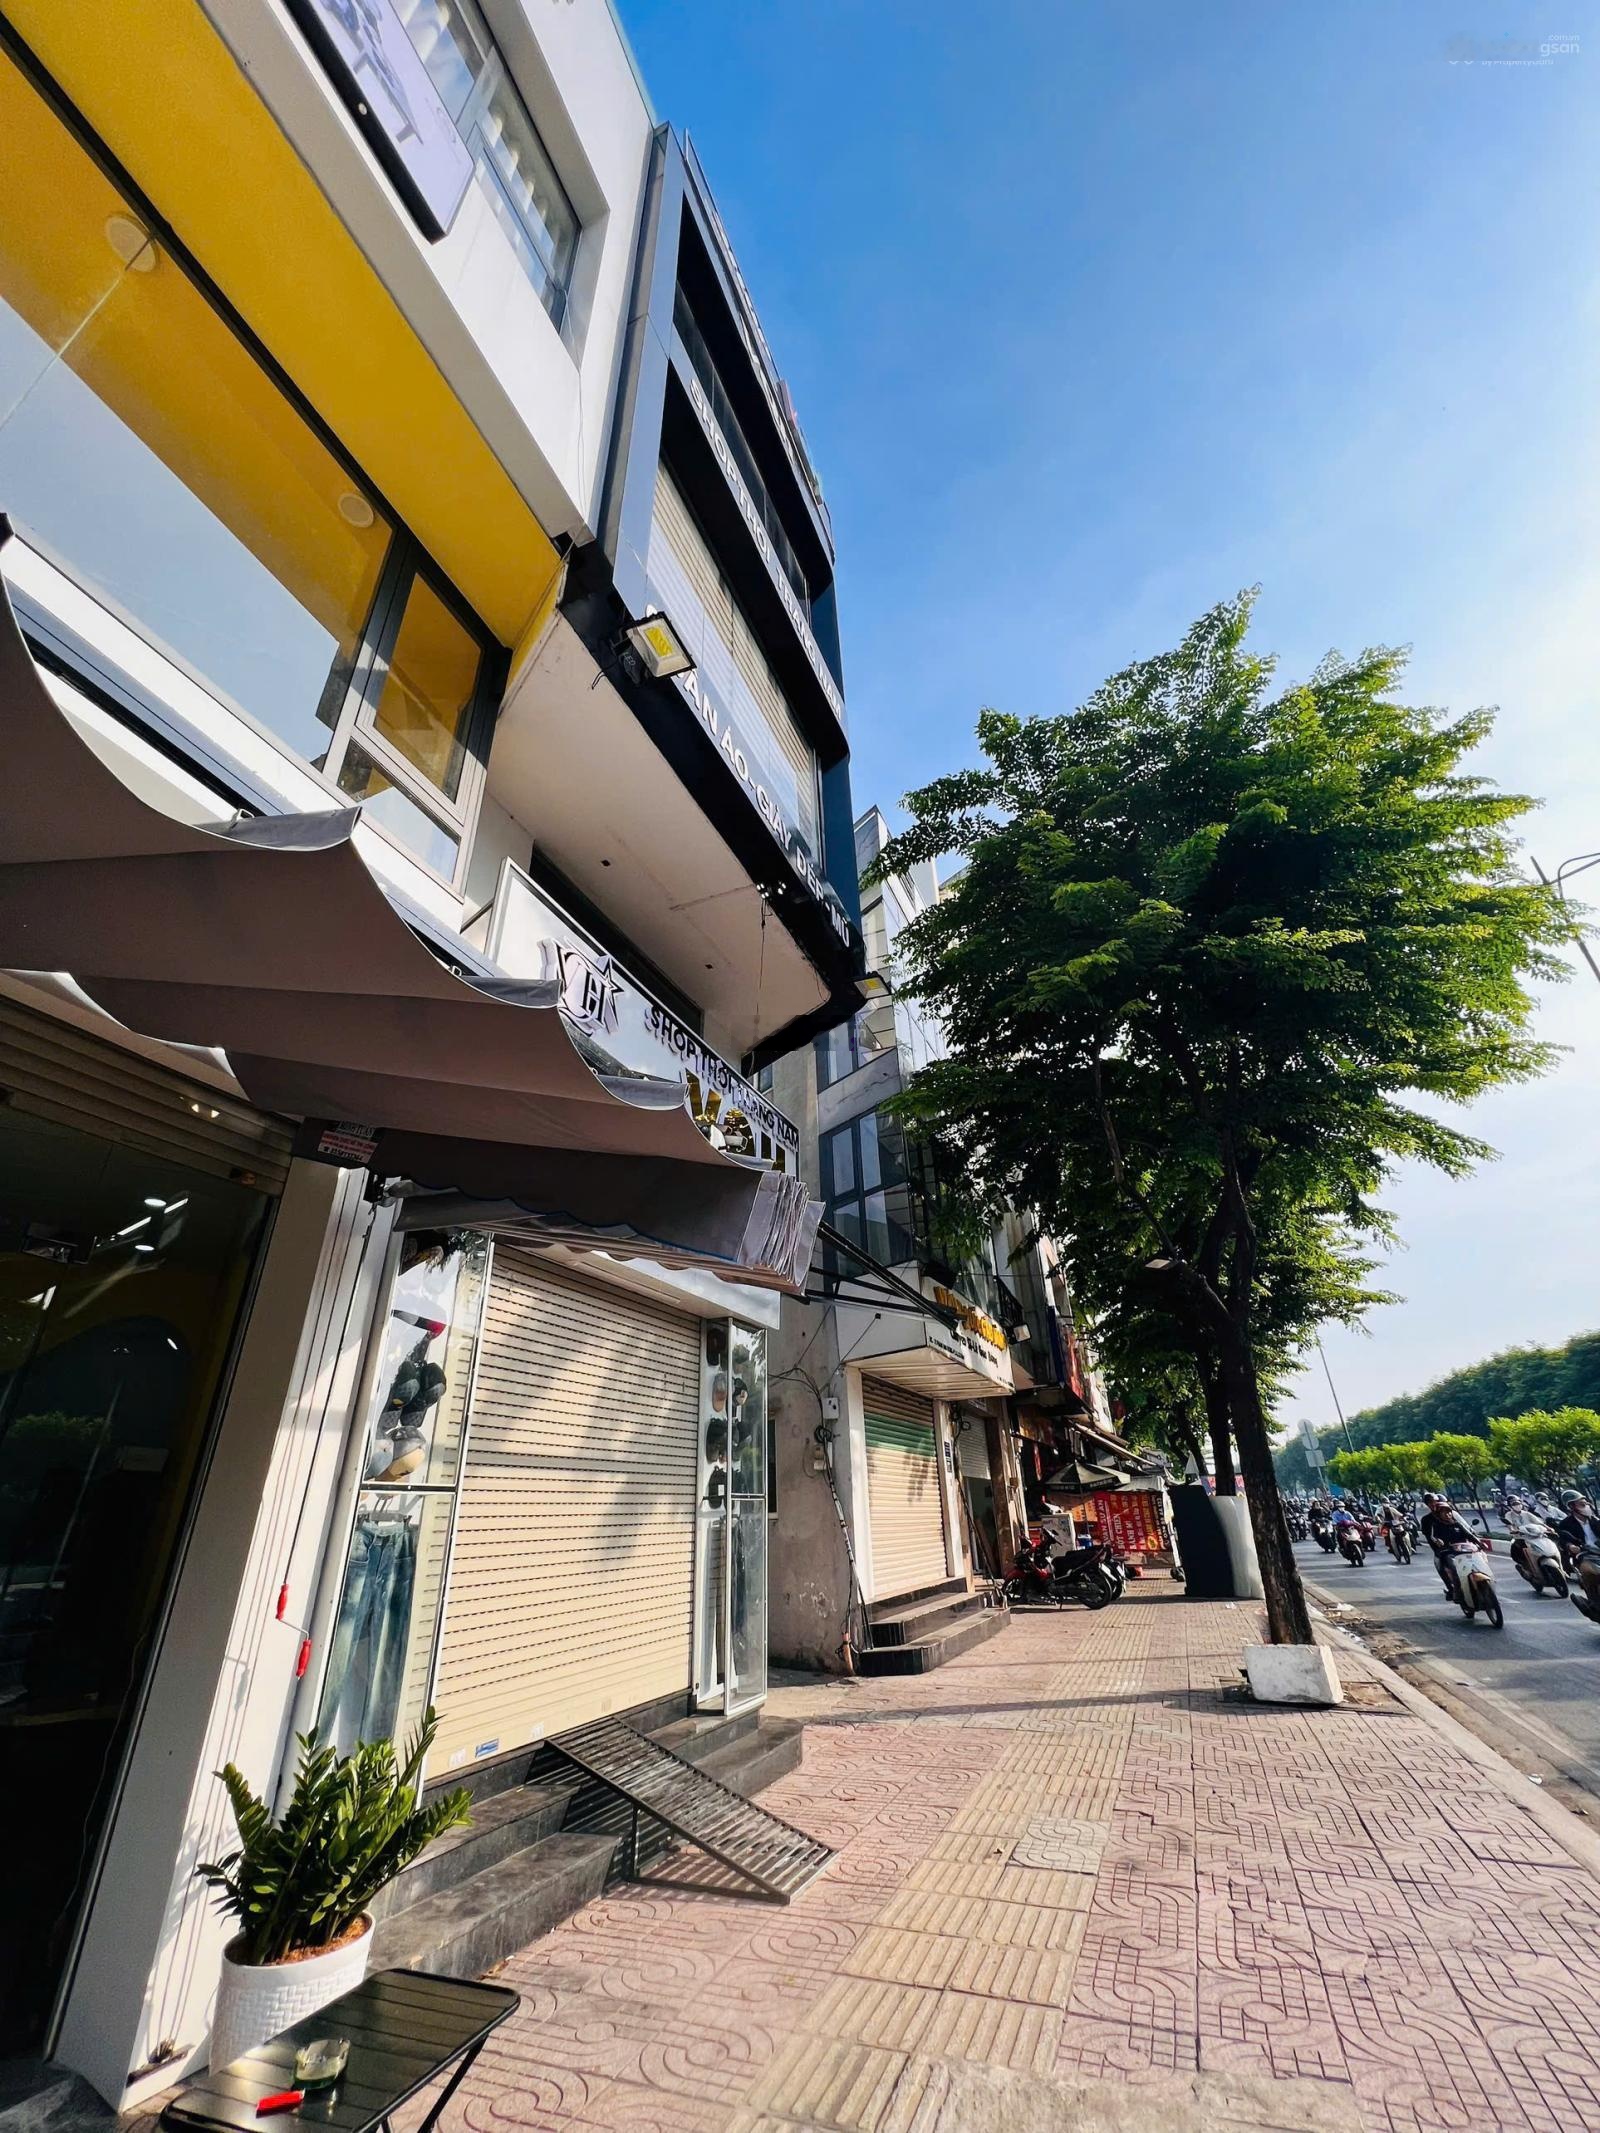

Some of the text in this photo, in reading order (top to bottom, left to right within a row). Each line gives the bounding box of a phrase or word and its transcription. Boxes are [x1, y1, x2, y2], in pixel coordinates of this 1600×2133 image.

[690, 378, 738, 483] SHOP
[775, 565, 817, 665] TRANG
[818, 664, 842, 721] NAM
[646, 1003, 697, 1061] SHOP
[776, 1116, 800, 1152] NAM
